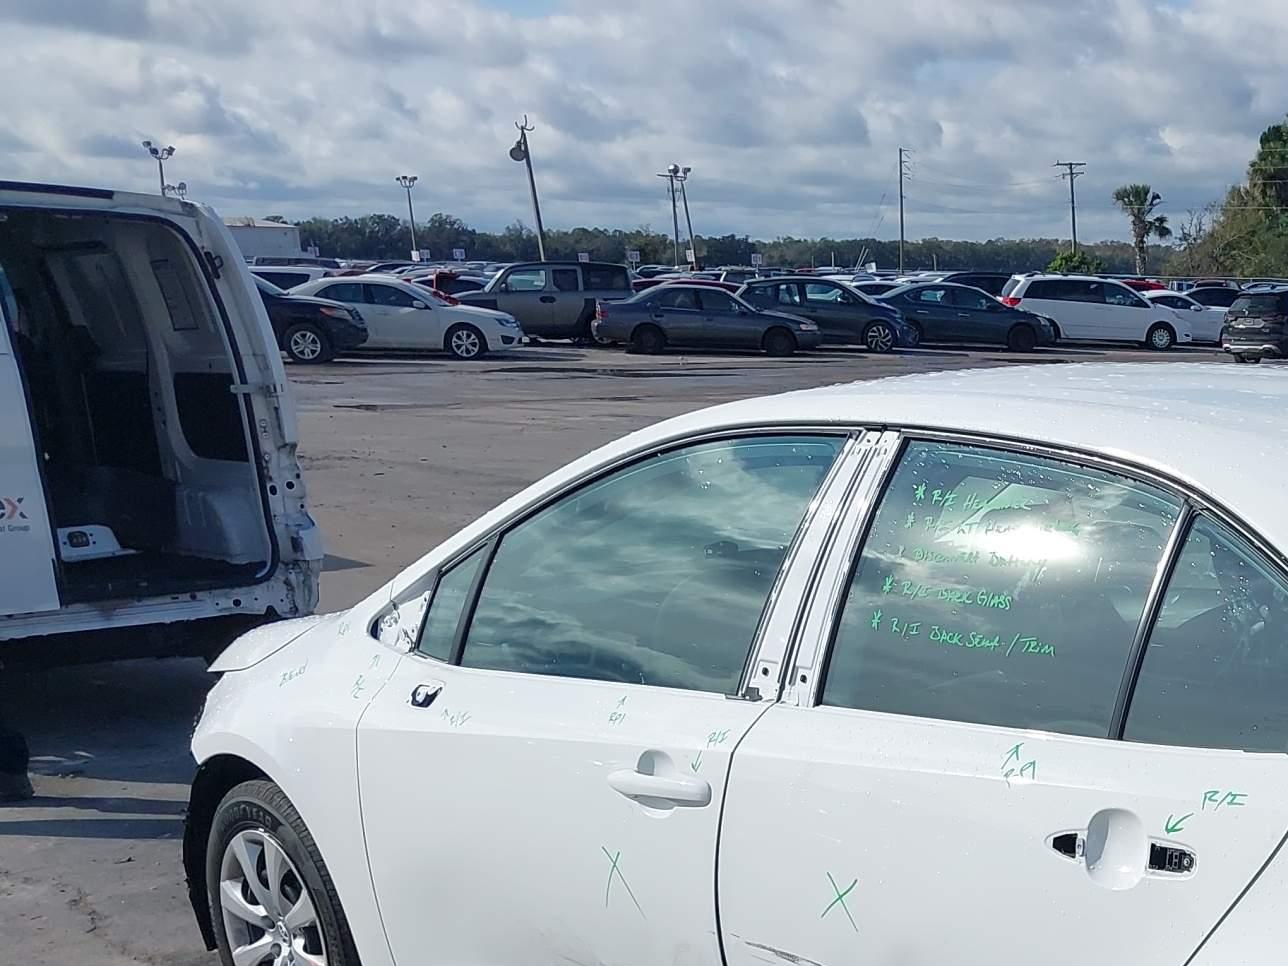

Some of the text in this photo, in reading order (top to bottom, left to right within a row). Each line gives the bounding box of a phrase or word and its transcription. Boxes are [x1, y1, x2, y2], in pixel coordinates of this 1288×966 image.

[891, 618, 921, 637] R/I
[707, 728, 730, 748] R/I
[1202, 789, 1249, 812] R/I
